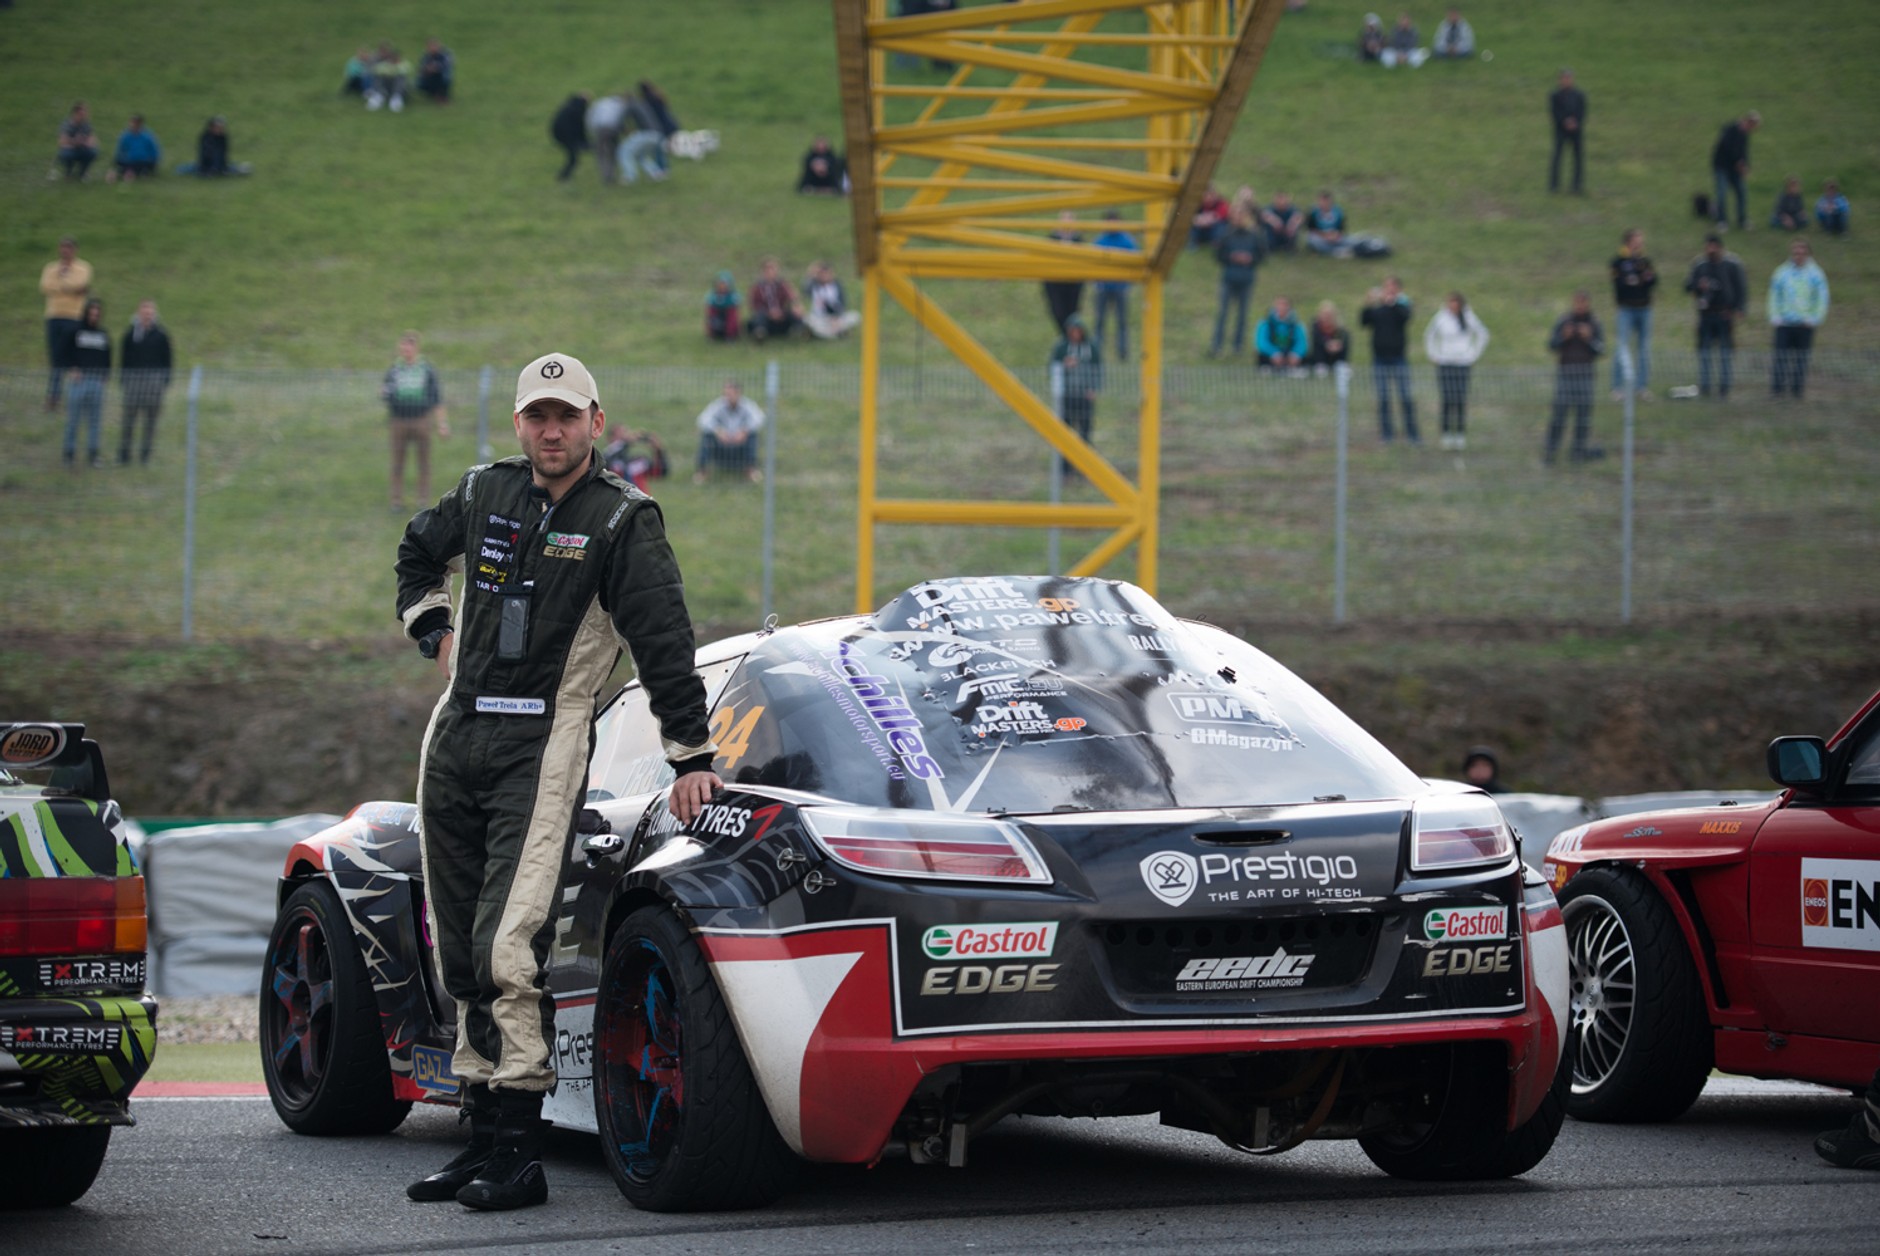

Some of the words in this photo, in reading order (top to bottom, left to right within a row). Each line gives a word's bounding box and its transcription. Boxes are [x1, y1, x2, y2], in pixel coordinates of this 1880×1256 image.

[985, 690, 1068, 701] PERFORMANCE
[975, 700, 1049, 723] Drift
[709, 705, 766, 769] 24
[691, 803, 752, 837] TYRES
[1700, 822, 1742, 834] MAXXIS
[1200, 850, 1358, 885] Prestigio
[1208, 891, 1240, 902] THE
[1246, 889, 1276, 899] ART
[1282, 888, 1300, 898] OF
[1306, 888, 1362, 898] HI-TECH
[1805, 897, 1827, 908] ENEOS
[1447, 911, 1504, 937] Castrol
[955, 927, 1048, 954] Castrol
[1422, 945, 1512, 977] EDGE
[54, 977, 113, 986] PERFORMANCE
[115, 976, 137, 984] TYRES
[920, 963, 1062, 996] EDGE
[1176, 981, 1204, 991] EASTERN
[1204, 981, 1238, 990] EUROPEAN
[1239, 979, 1257, 988] DRIFT
[1257, 977, 1304, 988] CHAMPIONSHIP
[1, 1026, 119, 1049] EXTREME
[16, 1041, 75, 1049] PERFORMANCE
[78, 1042, 103, 1050] TYRES
[415, 1052, 460, 1087] GAZ
